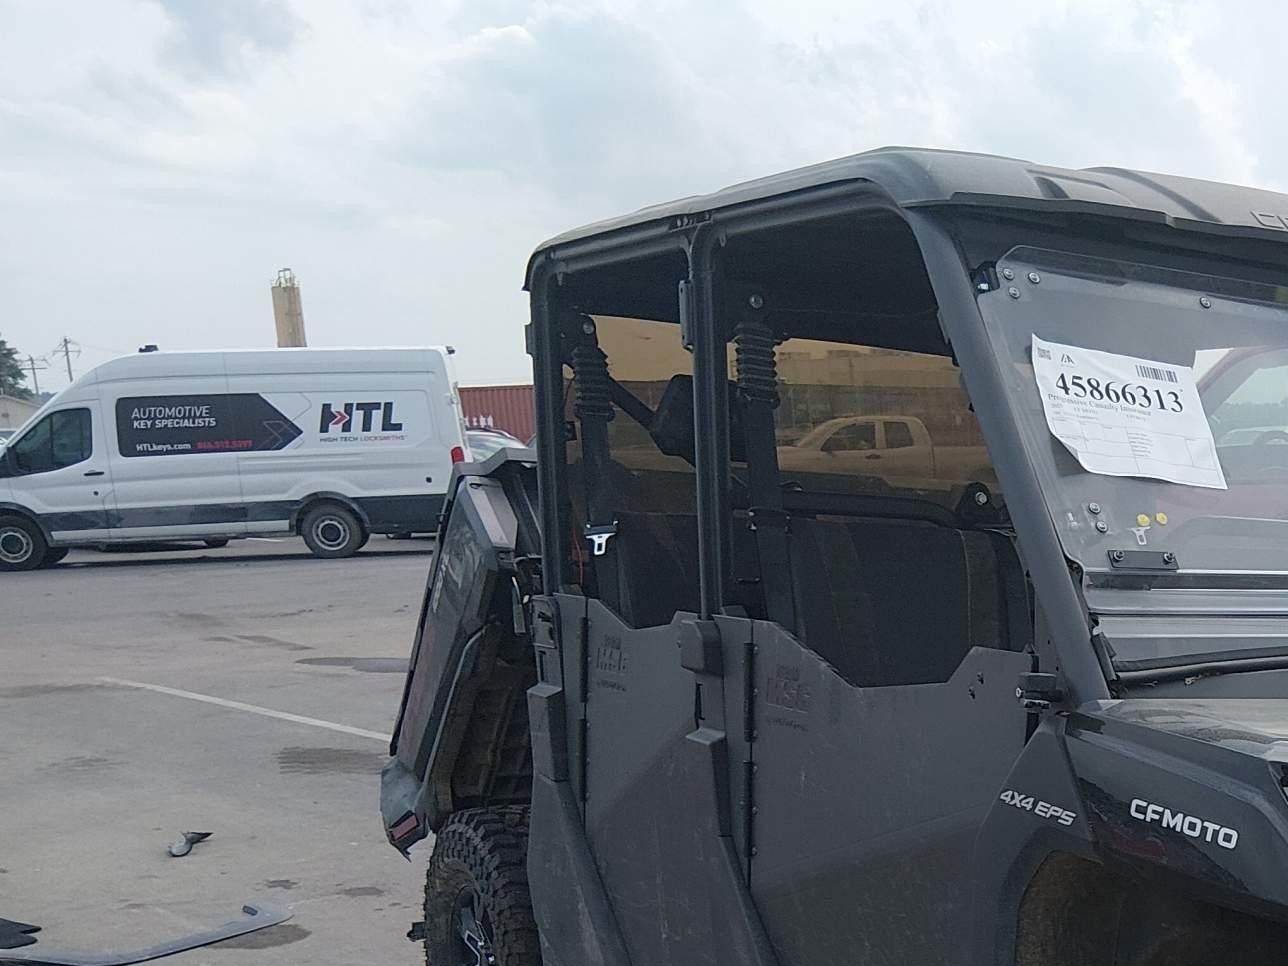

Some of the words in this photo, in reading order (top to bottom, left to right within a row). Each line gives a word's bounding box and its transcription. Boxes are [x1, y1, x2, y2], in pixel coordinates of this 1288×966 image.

[1056, 373, 1183, 413] 45866313
[131, 405, 211, 419] AUTOMOTIVE
[133, 419, 152, 429] KEY
[155, 418, 217, 428] SPECIALISTS
[320, 402, 403, 433] HTL
[136, 443, 192, 452] HTLkeys.com
[1033, 800, 1077, 827] EPS
[1130, 798, 1239, 850] CFMOTO
